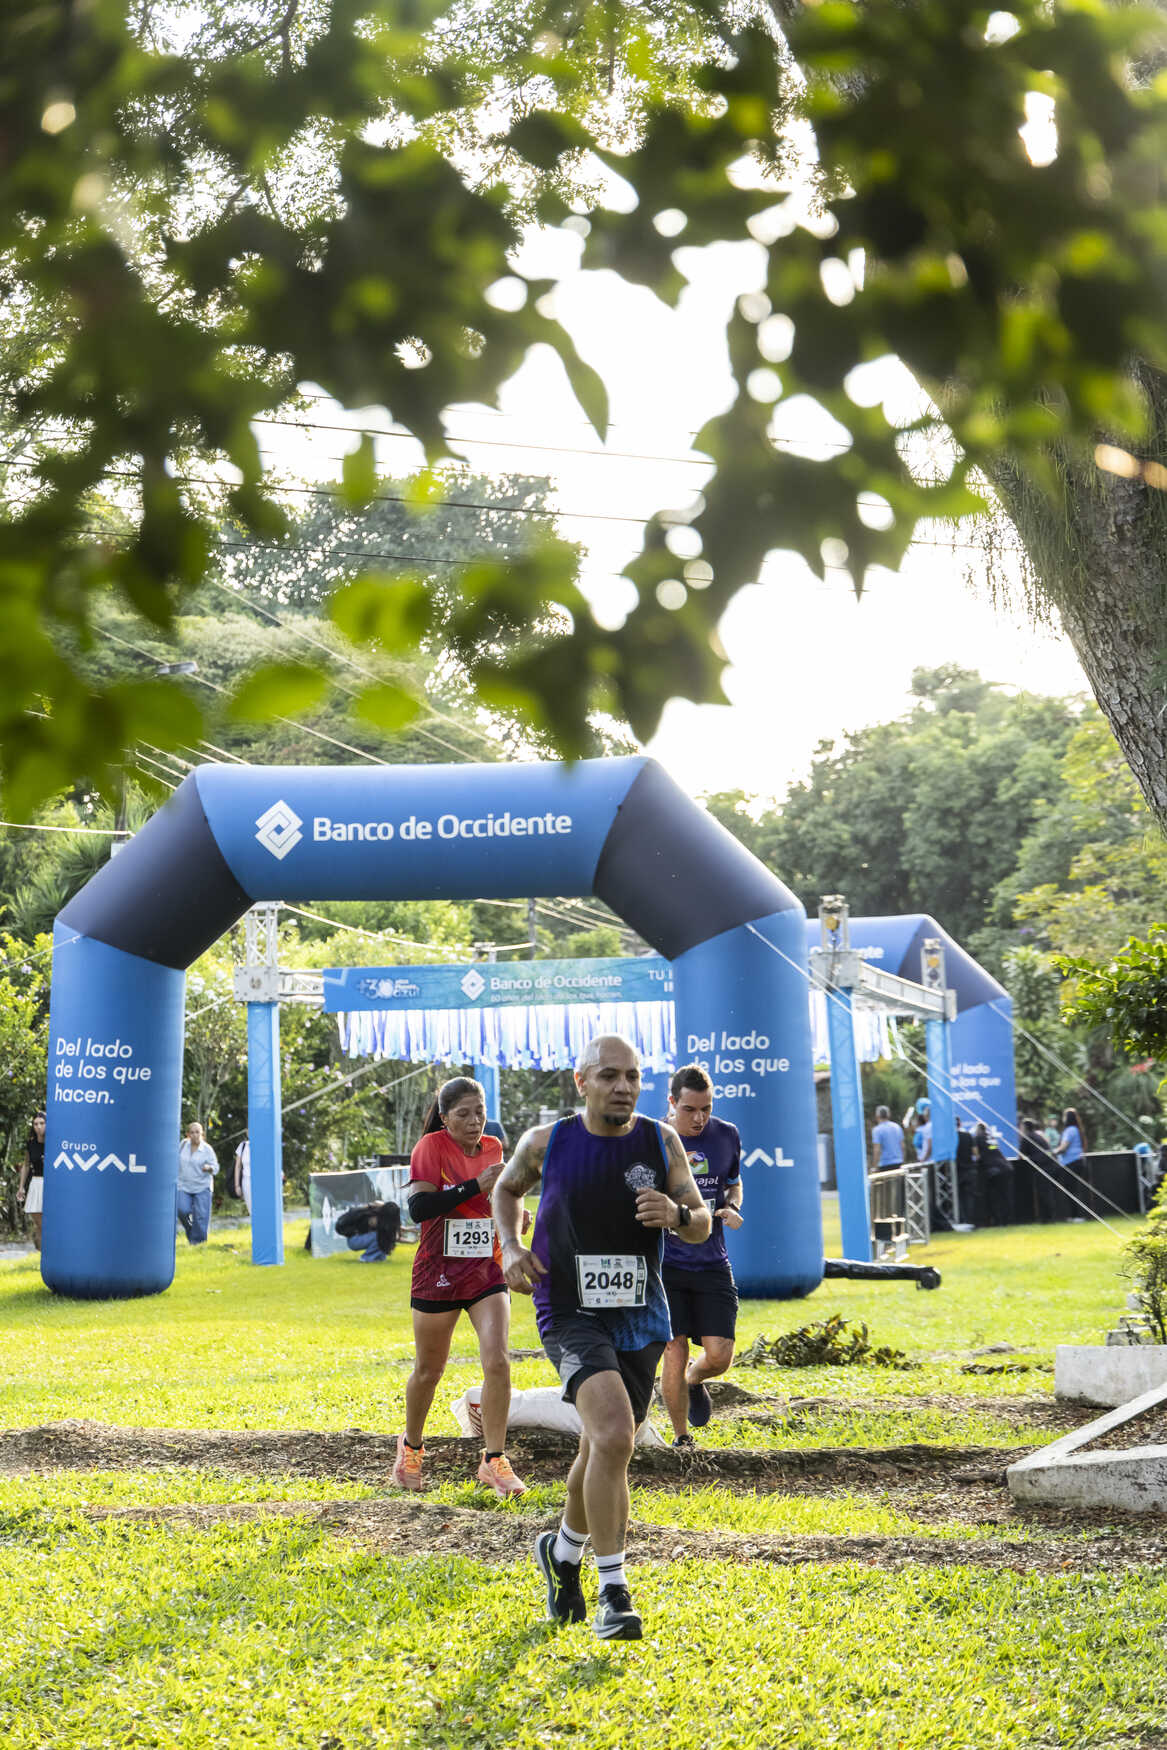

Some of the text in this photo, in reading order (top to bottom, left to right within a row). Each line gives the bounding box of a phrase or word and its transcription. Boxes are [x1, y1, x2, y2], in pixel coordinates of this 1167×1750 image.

[313, 812, 573, 842] Banco de Occidente
[490, 974, 623, 990] Banco de Occidente
[55, 1037, 133, 1059] Del lado
[687, 1030, 770, 1053] Del lado
[55, 1058, 152, 1085] de los que
[715, 1054, 745, 1074] los
[751, 1057, 790, 1077] que
[54, 1082, 115, 1105] hacen.
[61, 1140, 97, 1152] Grupo
[53, 1151, 147, 1174] AVAL
[453, 1231, 490, 1245] 1293
[584, 1271, 634, 1290] 2048
